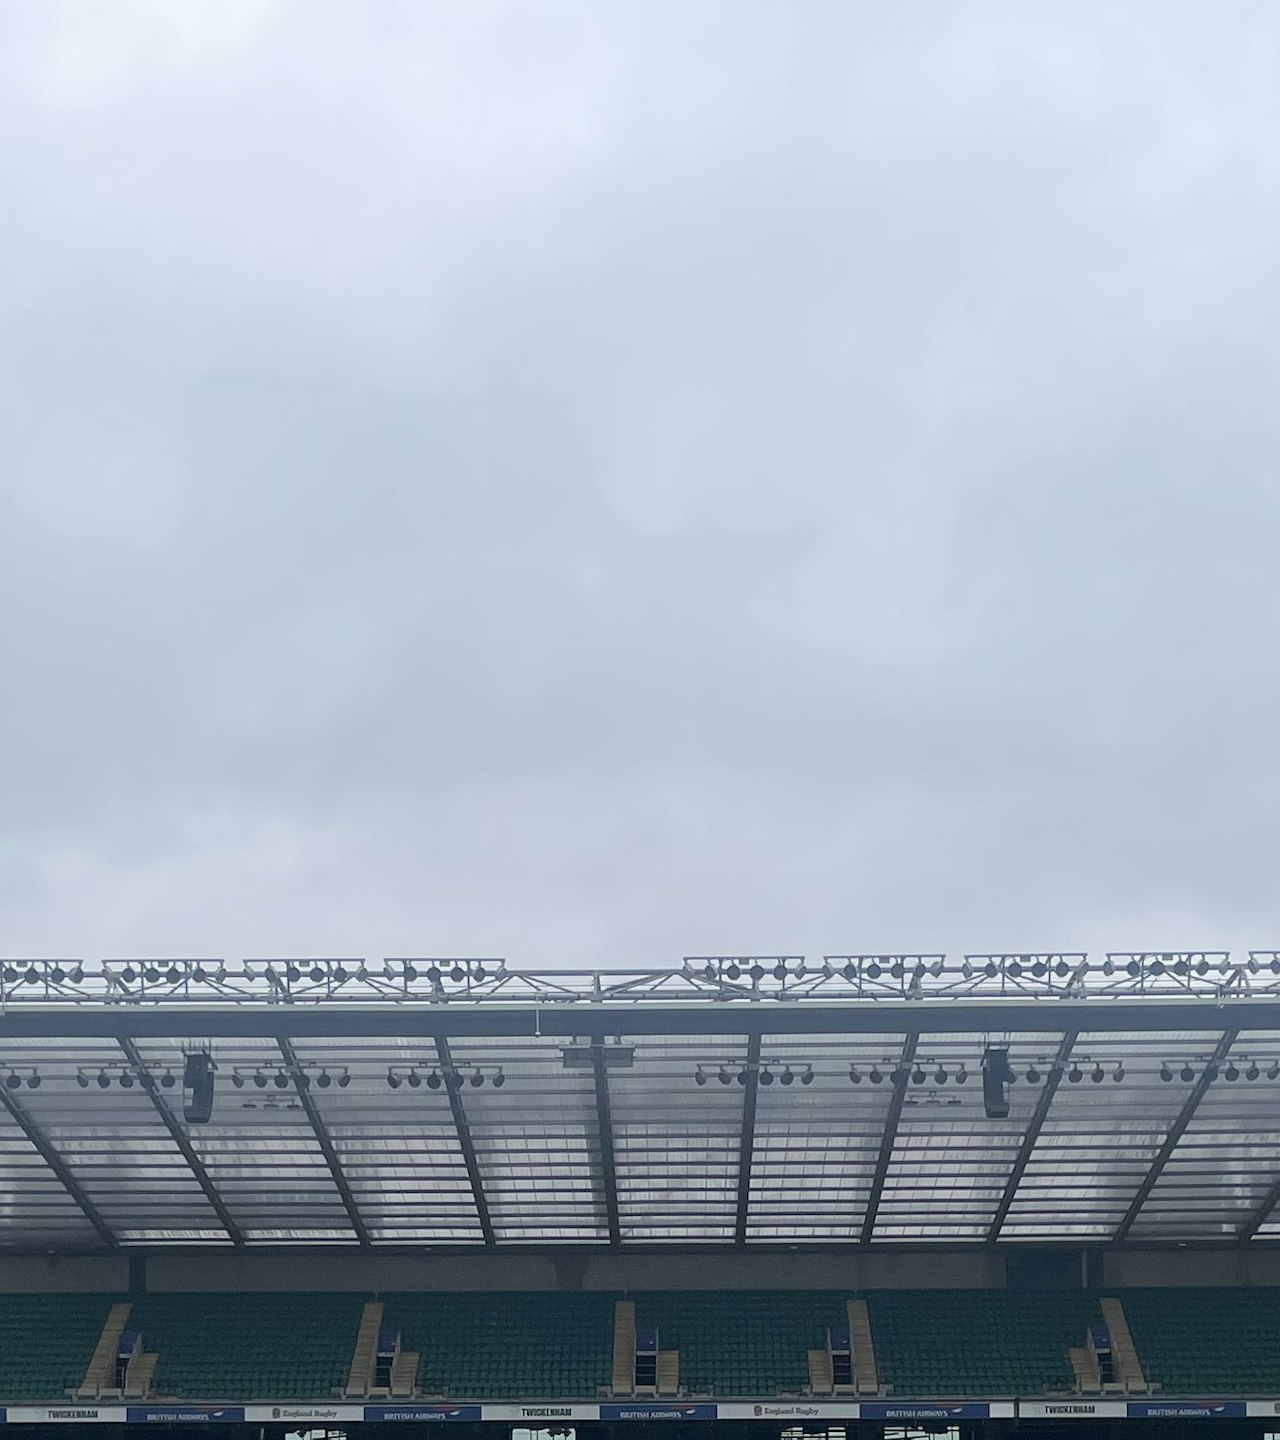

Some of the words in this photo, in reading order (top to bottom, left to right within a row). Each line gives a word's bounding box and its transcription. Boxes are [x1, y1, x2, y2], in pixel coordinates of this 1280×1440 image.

[283, 1410, 312, 1418] England
[314, 1410, 338, 1418] Rugby
[521, 1408, 572, 1417] TWICKENHAM
[764, 1407, 794, 1415] England
[795, 1407, 819, 1416] Rugby
[1045, 1405, 1095, 1414] TWICKENHAM
[48, 1410, 99, 1419] TWICKENHAM
